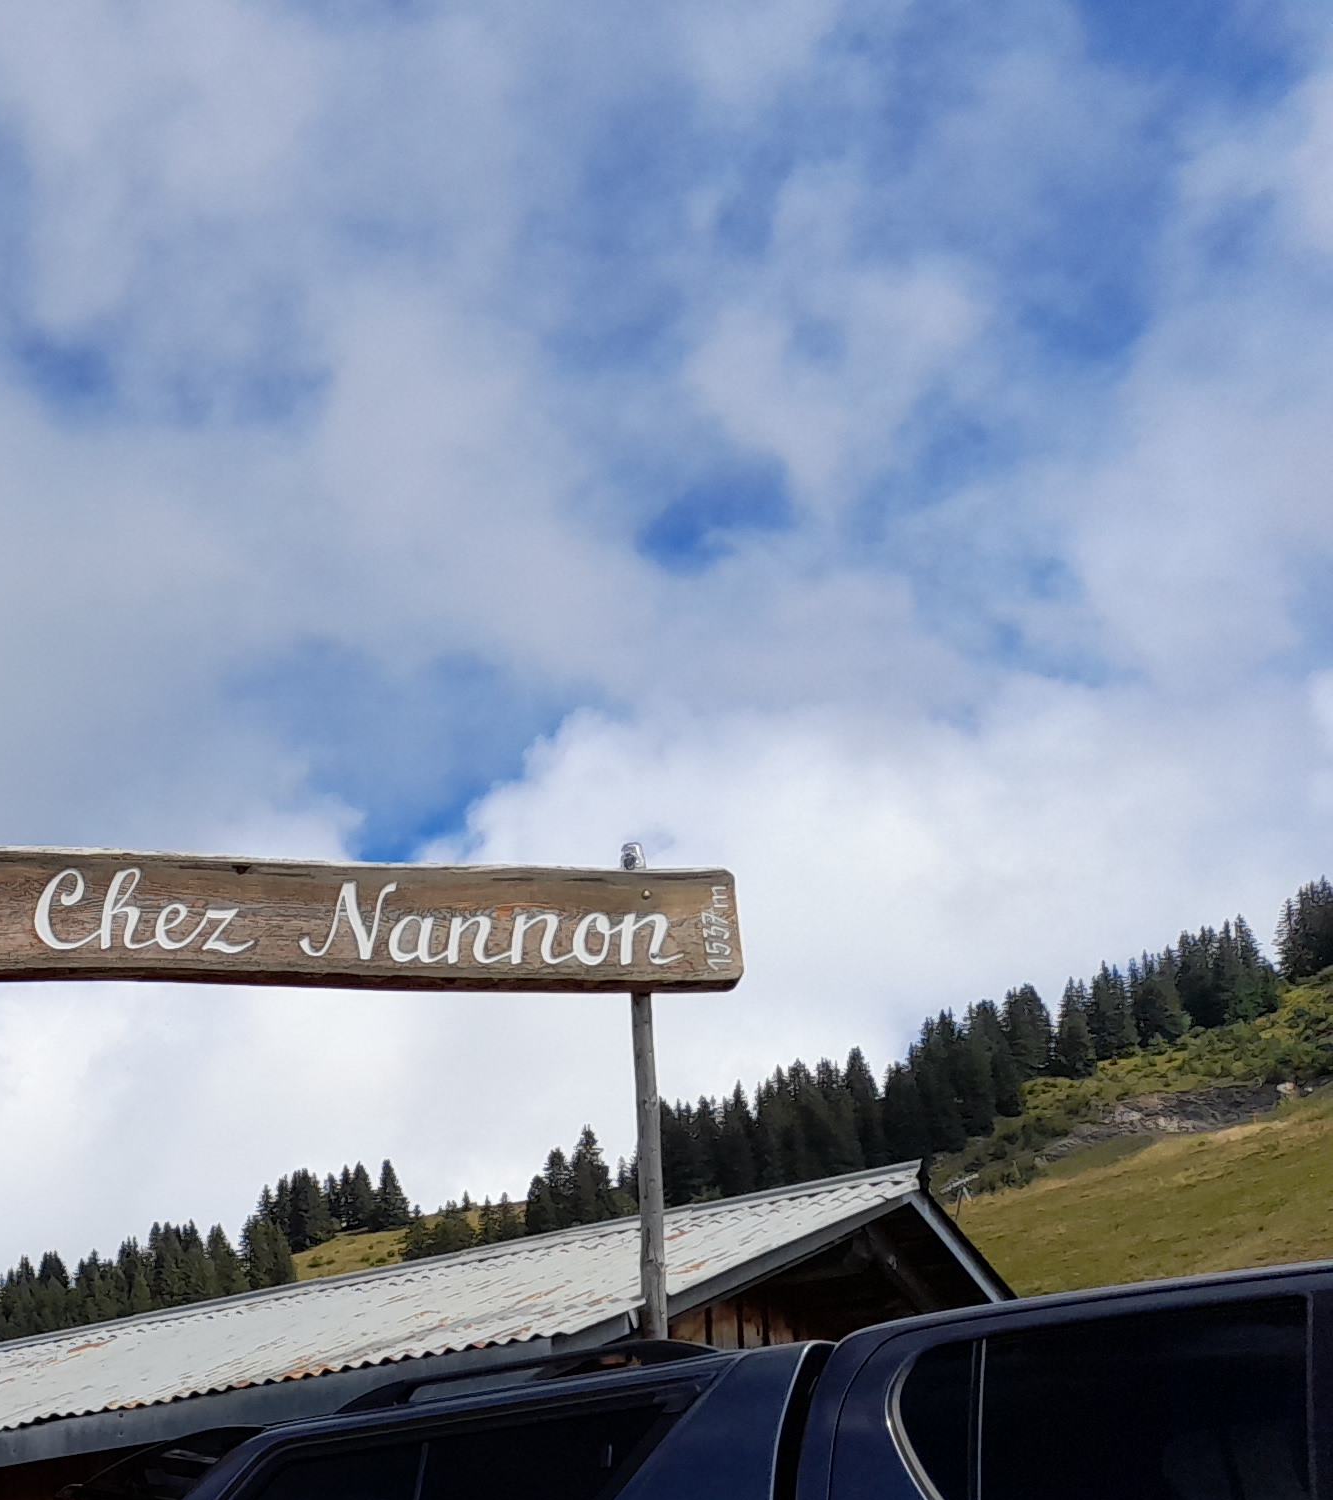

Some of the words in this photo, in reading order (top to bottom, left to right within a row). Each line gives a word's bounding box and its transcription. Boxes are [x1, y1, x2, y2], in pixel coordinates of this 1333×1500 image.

[34, 866, 257, 954] Chez
[298, 879, 685, 966] Nannon
[700, 911, 733, 971] 1537
